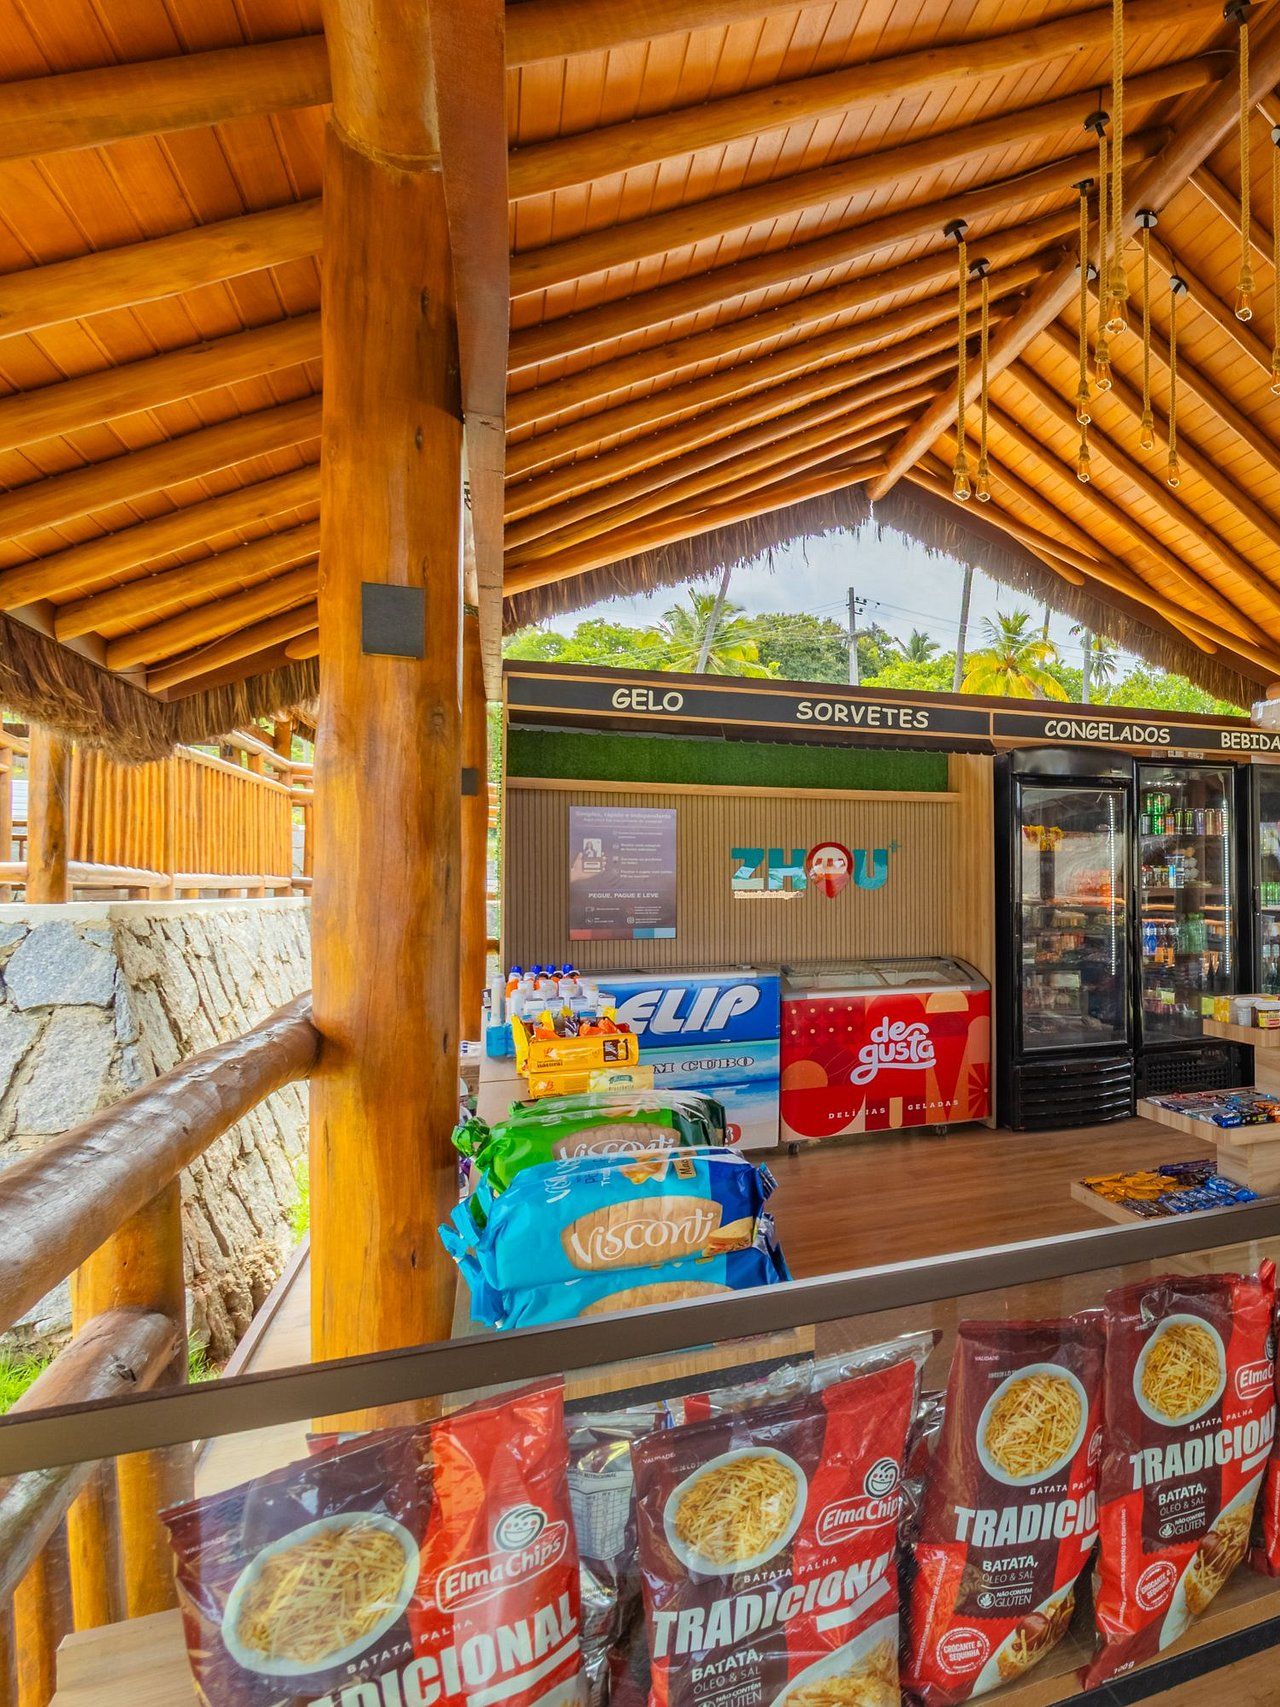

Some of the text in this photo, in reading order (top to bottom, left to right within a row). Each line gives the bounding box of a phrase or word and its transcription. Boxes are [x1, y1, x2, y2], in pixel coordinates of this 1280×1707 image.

[611, 688, 930, 728] GELO SORVETES
[1044, 720, 1171, 743] CONGELADOS
[731, 841, 889, 899] ZHOU
[682, 1057, 754, 1071] CUBO
[829, 1099, 959, 1119] DELÍIAS GELADAS
[570, 1208, 714, 1264] Visconti
[1189, 1407, 1253, 1432] BATATA PALHA
[1030, 1484, 1067, 1495] BATATA
[1158, 1483, 1207, 1505] BATATA,
[1191, 1496, 1205, 1506] SAL
[743, 1556, 838, 1584] BATATA PALHA
[982, 1555, 1039, 1572] BATATA,
[1010, 1573, 1016, 1581] &
[1018, 1570, 1034, 1580] SAL
[346, 1618, 473, 1675] BATATA PALHA
[691, 1648, 764, 1683] BATATA,
[729, 1673, 737, 1682] &
[740, 1666, 761, 1680] SAL
